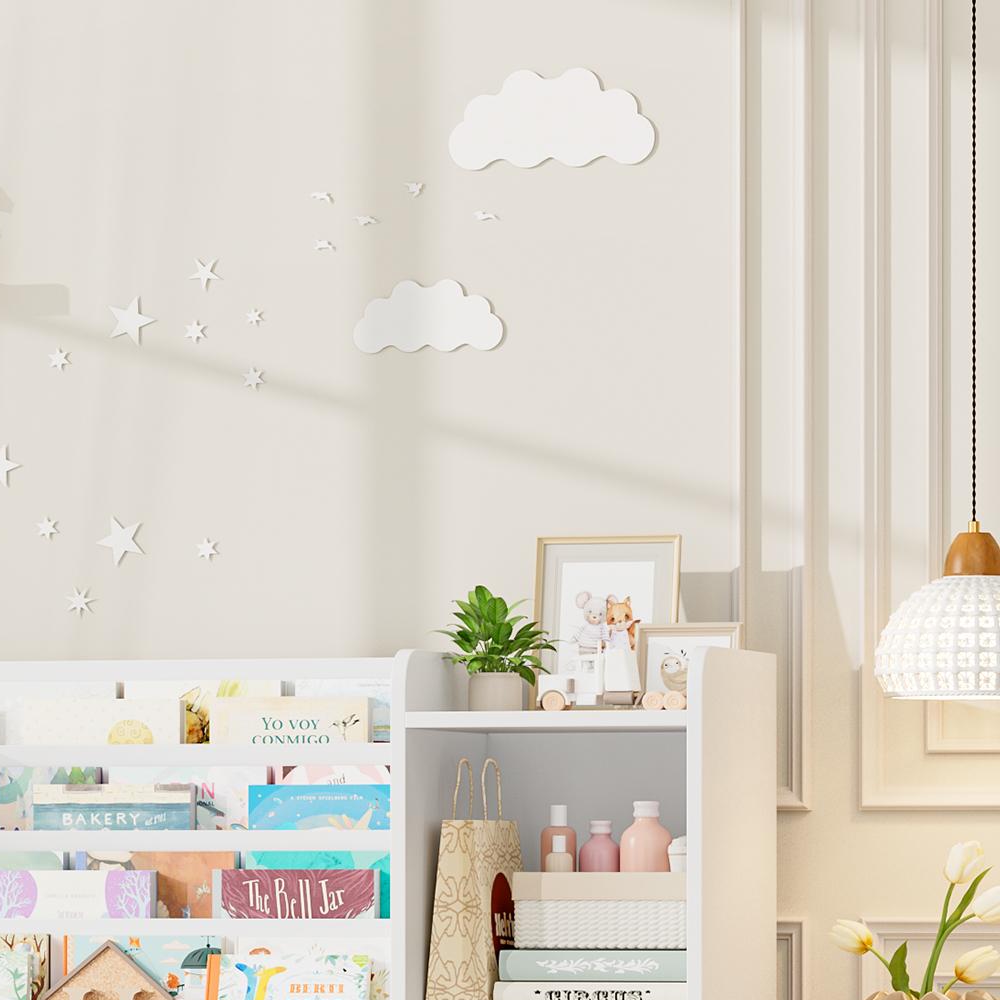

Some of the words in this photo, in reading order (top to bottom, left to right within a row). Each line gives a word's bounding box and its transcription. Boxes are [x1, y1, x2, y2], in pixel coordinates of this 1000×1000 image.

[62, 812, 140, 826] BAKERY
[242, 879, 271, 915] The
[274, 877, 313, 919] Bell
[319, 879, 345, 915] Jar
